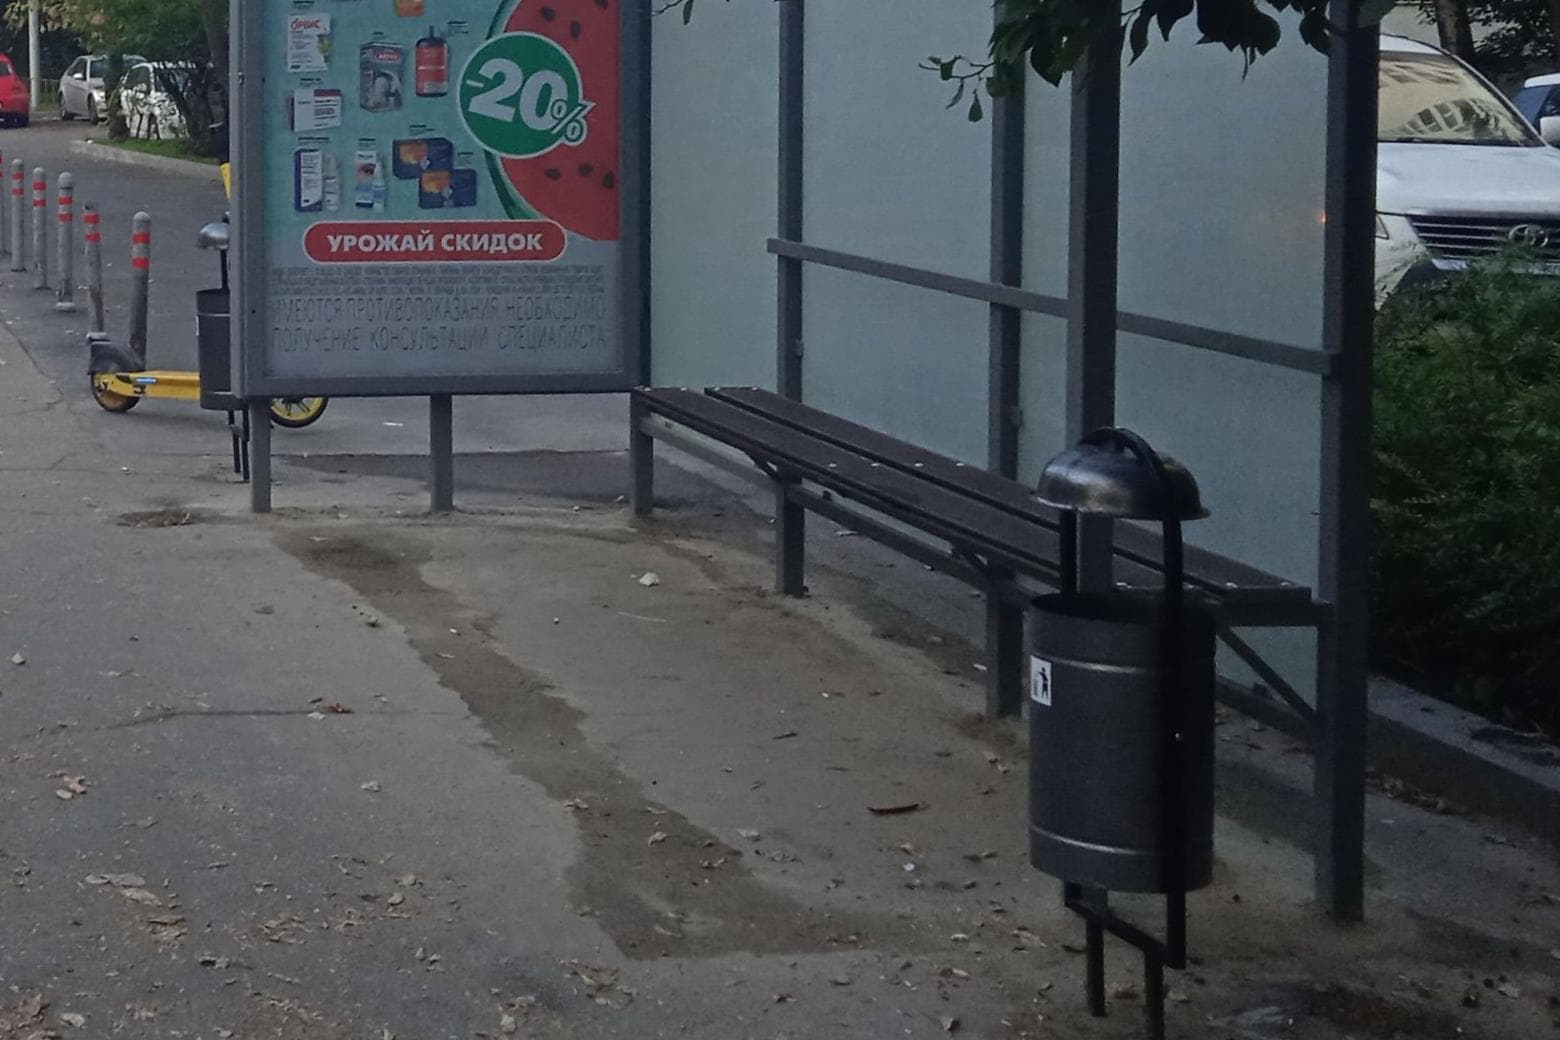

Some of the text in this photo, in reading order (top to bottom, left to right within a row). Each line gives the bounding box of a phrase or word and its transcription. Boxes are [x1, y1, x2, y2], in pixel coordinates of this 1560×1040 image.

[466, 57, 590, 144] -20%
[327, 229, 542, 253] УРОЖАЙ СКИДОК
